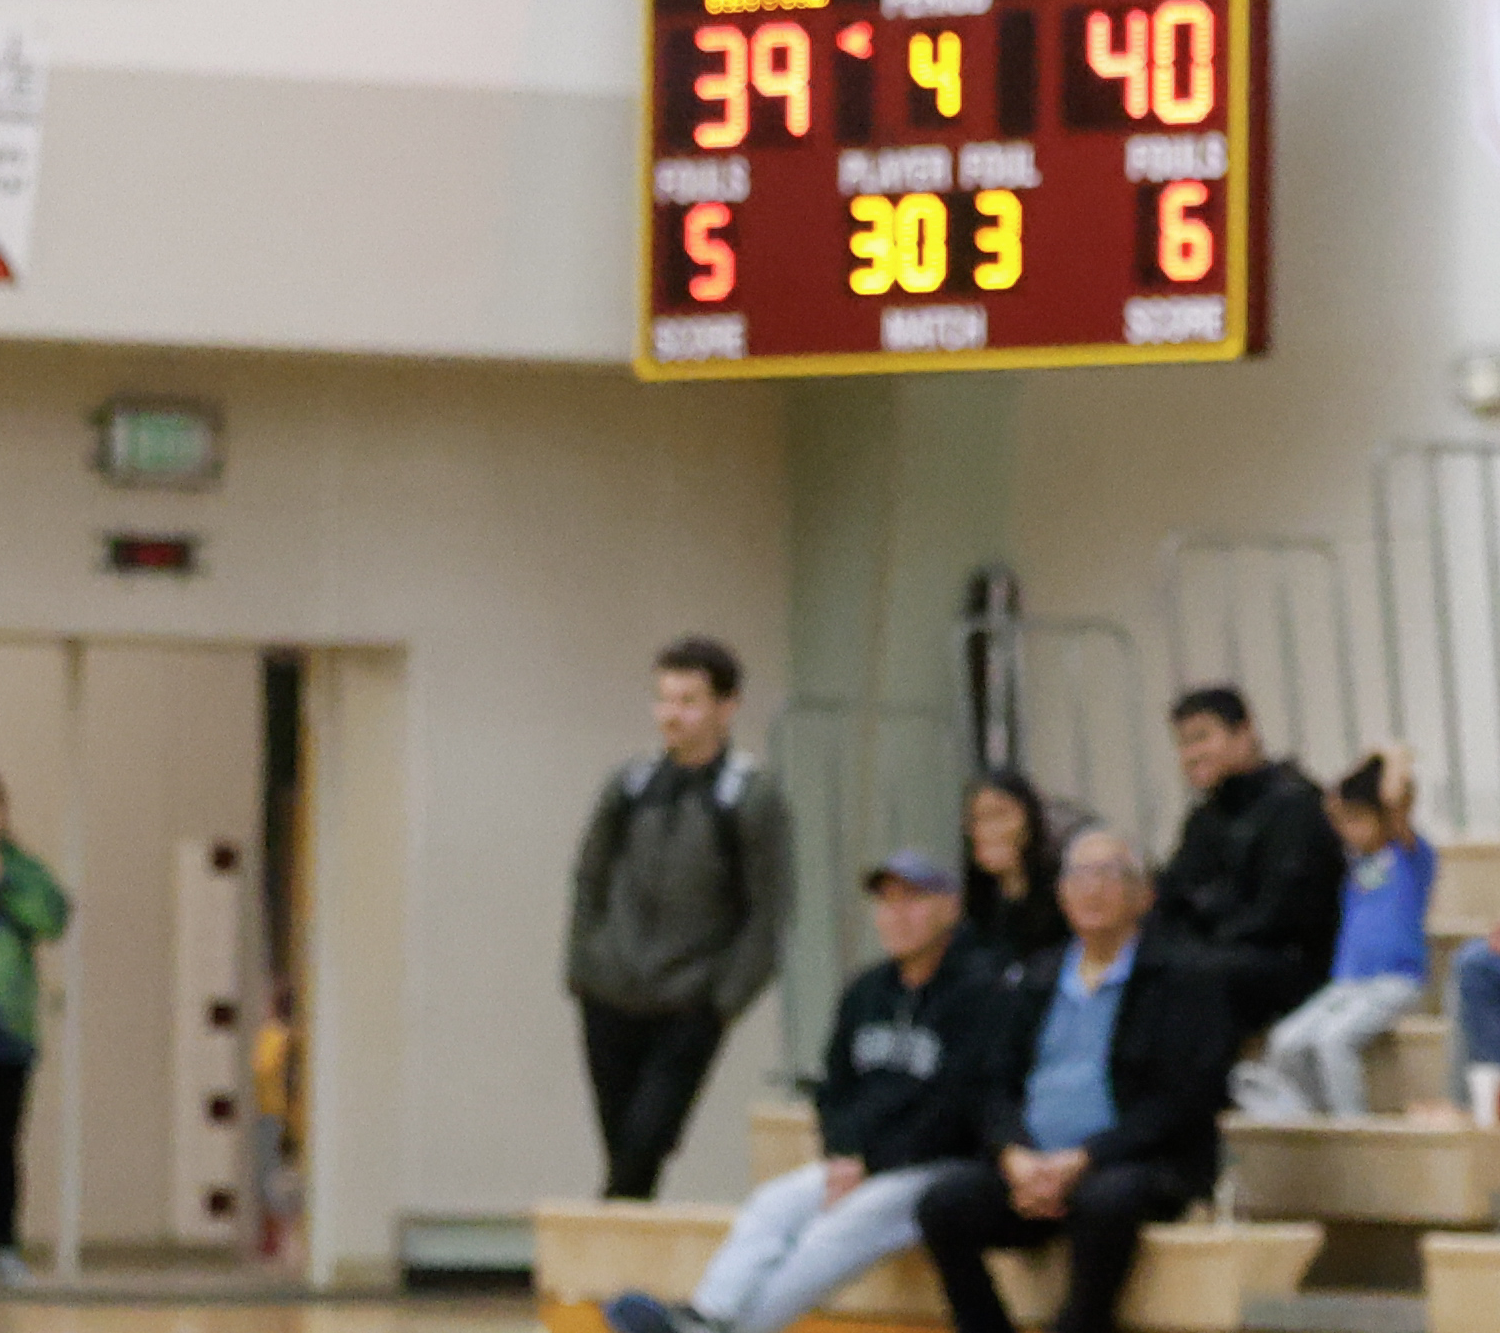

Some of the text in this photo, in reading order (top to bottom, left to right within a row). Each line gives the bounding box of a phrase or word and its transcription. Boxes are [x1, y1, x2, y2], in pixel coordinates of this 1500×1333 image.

[694, 23, 810, 149] 39
[909, 31, 962, 118] 4
[685, 201, 736, 302] 5
[848, 192, 948, 295] 30
[973, 188, 1023, 290] 3
[1158, 179, 1212, 282] 6
